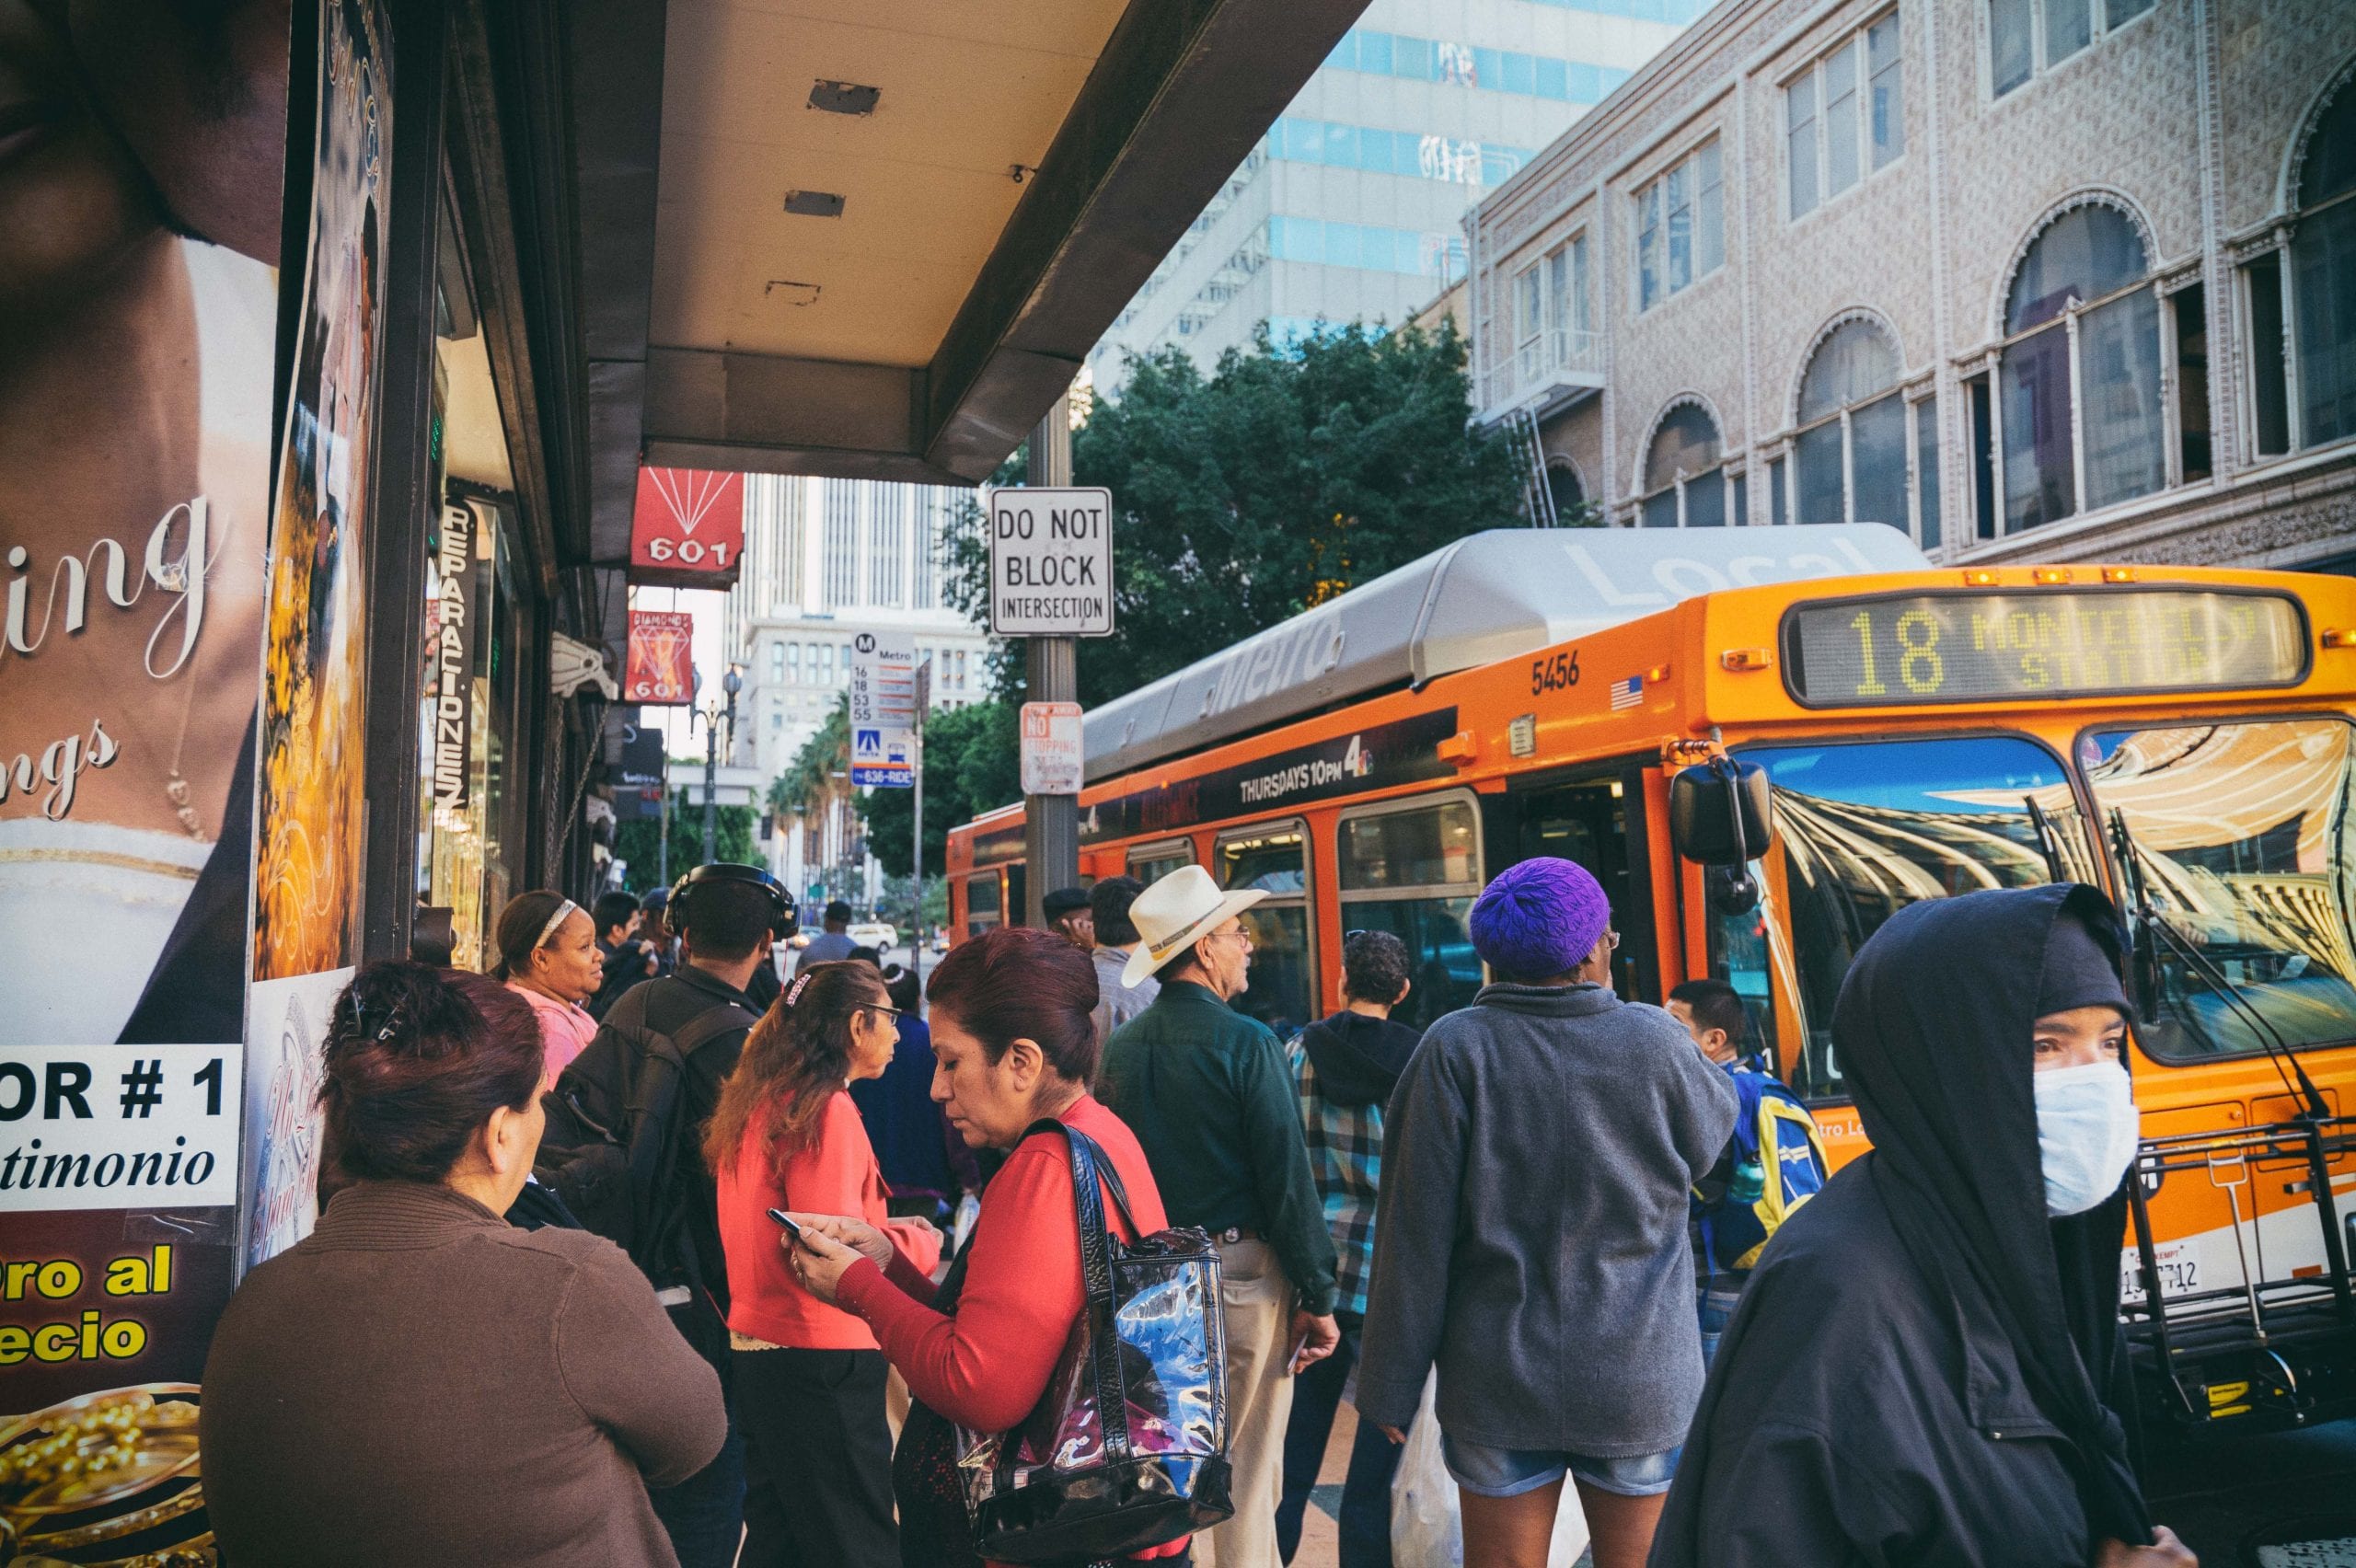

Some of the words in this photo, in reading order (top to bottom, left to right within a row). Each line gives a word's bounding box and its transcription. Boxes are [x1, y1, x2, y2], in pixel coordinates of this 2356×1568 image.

[999, 509, 1034, 539] DO
[1051, 509, 1102, 539] NOT
[650, 537, 727, 565] 601
[1007, 555, 1096, 586] BLOCK
[1002, 597, 1103, 619] INTERSECTION
[435, 505, 469, 794] REPARACIONES
[880, 651, 911, 661] Metro
[1850, 610, 1944, 696] 18
[854, 680, 868, 691] 18
[855, 666, 868, 677] 16
[1531, 649, 1579, 697] 5456
[635, 681, 684, 698] 601
[854, 694, 869, 706] 53
[854, 708, 872, 721] 55
[1240, 764, 1310, 803] THURSDAYS
[1345, 734, 1368, 778] 4
[0, 1062, 94, 1122] OR
[120, 1059, 163, 1119] #
[193, 1058, 223, 1116] 1
[0, 1136, 215, 1191] timonio
[0, 1258, 84, 1302] ro
[105, 1243, 173, 1297] al
[0, 1309, 148, 1366] ecio
